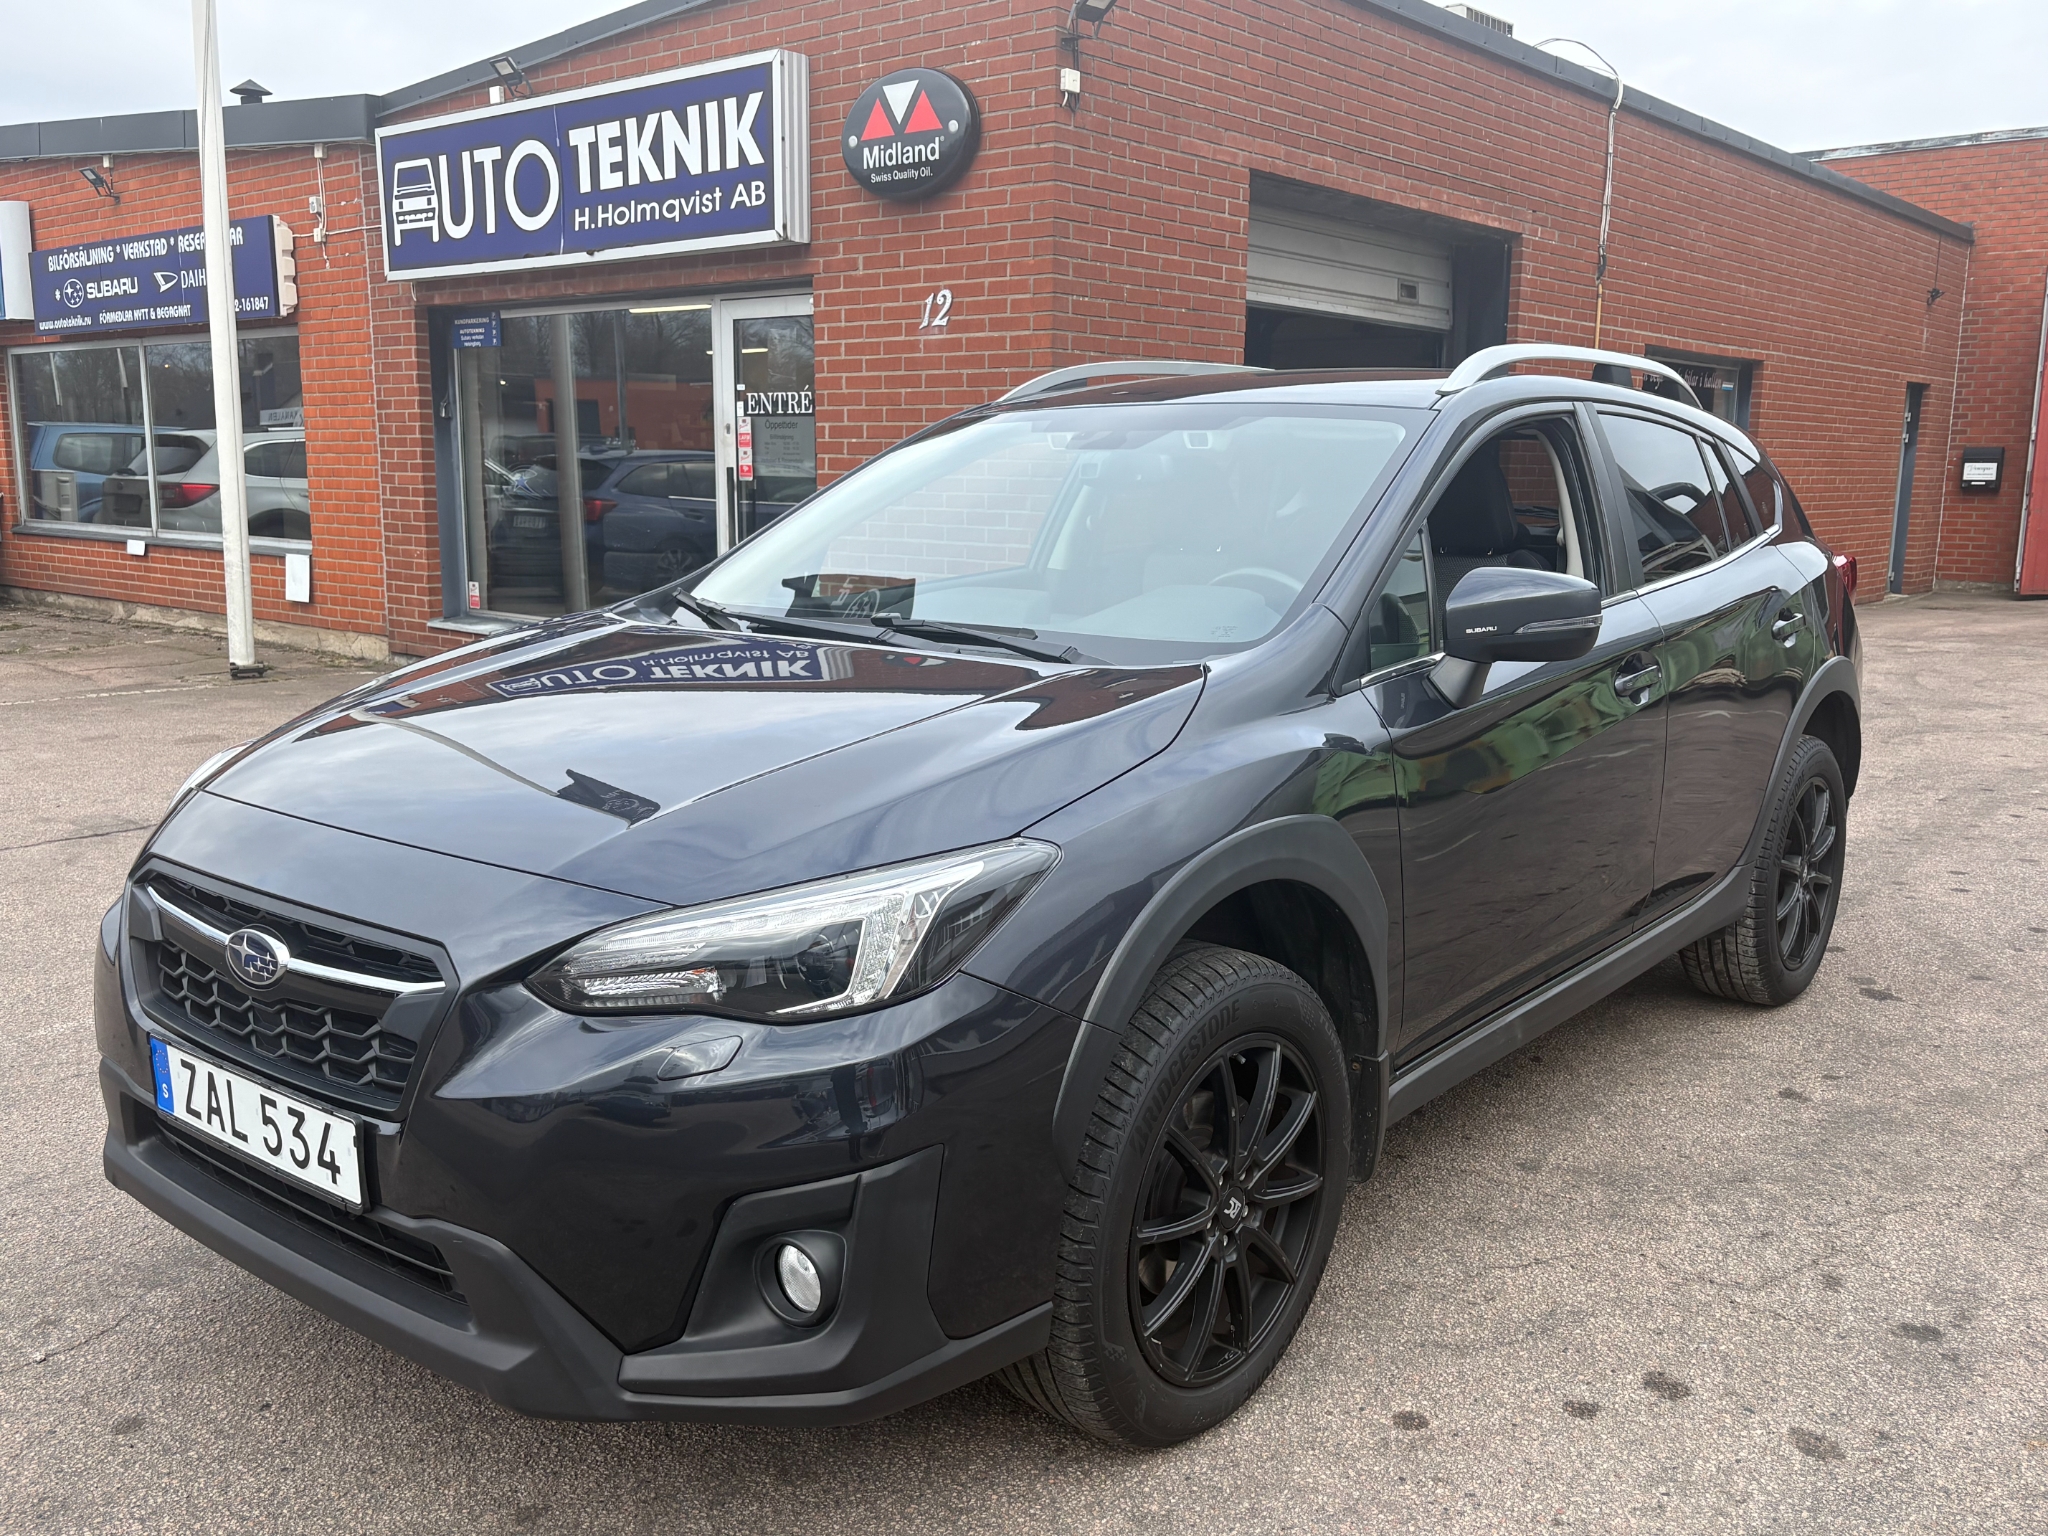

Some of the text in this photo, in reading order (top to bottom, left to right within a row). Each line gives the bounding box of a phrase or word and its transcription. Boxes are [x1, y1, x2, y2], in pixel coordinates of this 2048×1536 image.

[568, 91, 765, 194] TEKNIK
[863, 137, 940, 170] Midland
[870, 172, 892, 183] Swiss
[893, 168, 919, 180] Quality
[574, 180, 766, 231] H.Holmqvist AB
[48, 246, 114, 272] BILFÖRSÄLJNING
[122, 238, 168, 260] VERKSTAD
[86, 277, 139, 299] SUBARU
[100, 310, 133, 324] FÖRMEDLAR
[134, 308, 148, 321] NYTT
[150, 307, 156, 319] &
[156, 304, 191, 319] BEGAGNAT
[919, 289, 952, 329] 12
[746, 385, 813, 415] ENTRÉ
[1465, 626, 1497, 634] SUBARU
[162, 1083, 169, 1099] S
[1129, 998, 1240, 1159] BRIDGESTONE
[180, 1058, 341, 1185] ZAL 534
